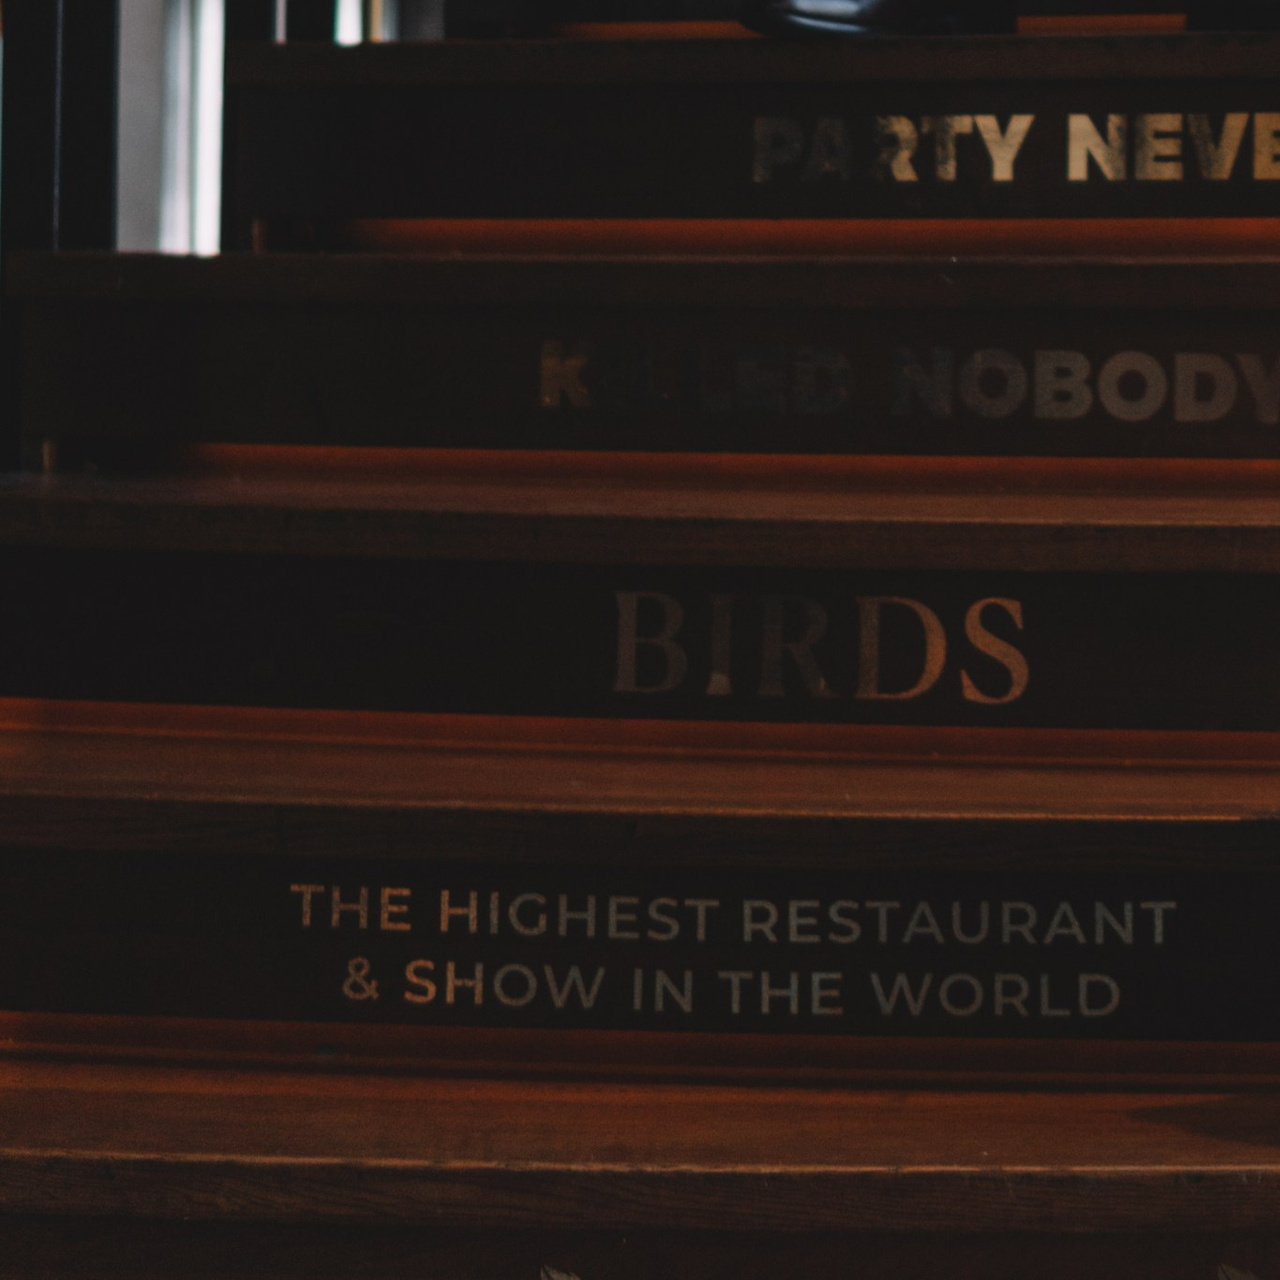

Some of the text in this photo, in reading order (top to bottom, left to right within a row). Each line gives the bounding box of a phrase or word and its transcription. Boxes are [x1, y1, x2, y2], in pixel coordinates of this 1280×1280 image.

[752, 112, 1037, 183] PARTY
[613, 589, 1030, 705] BIRDS
[290, 884, 1178, 947] THE HIGHEST RESTAURANT
[342, 955, 1122, 1019] & SHOW IN THE WORLD
